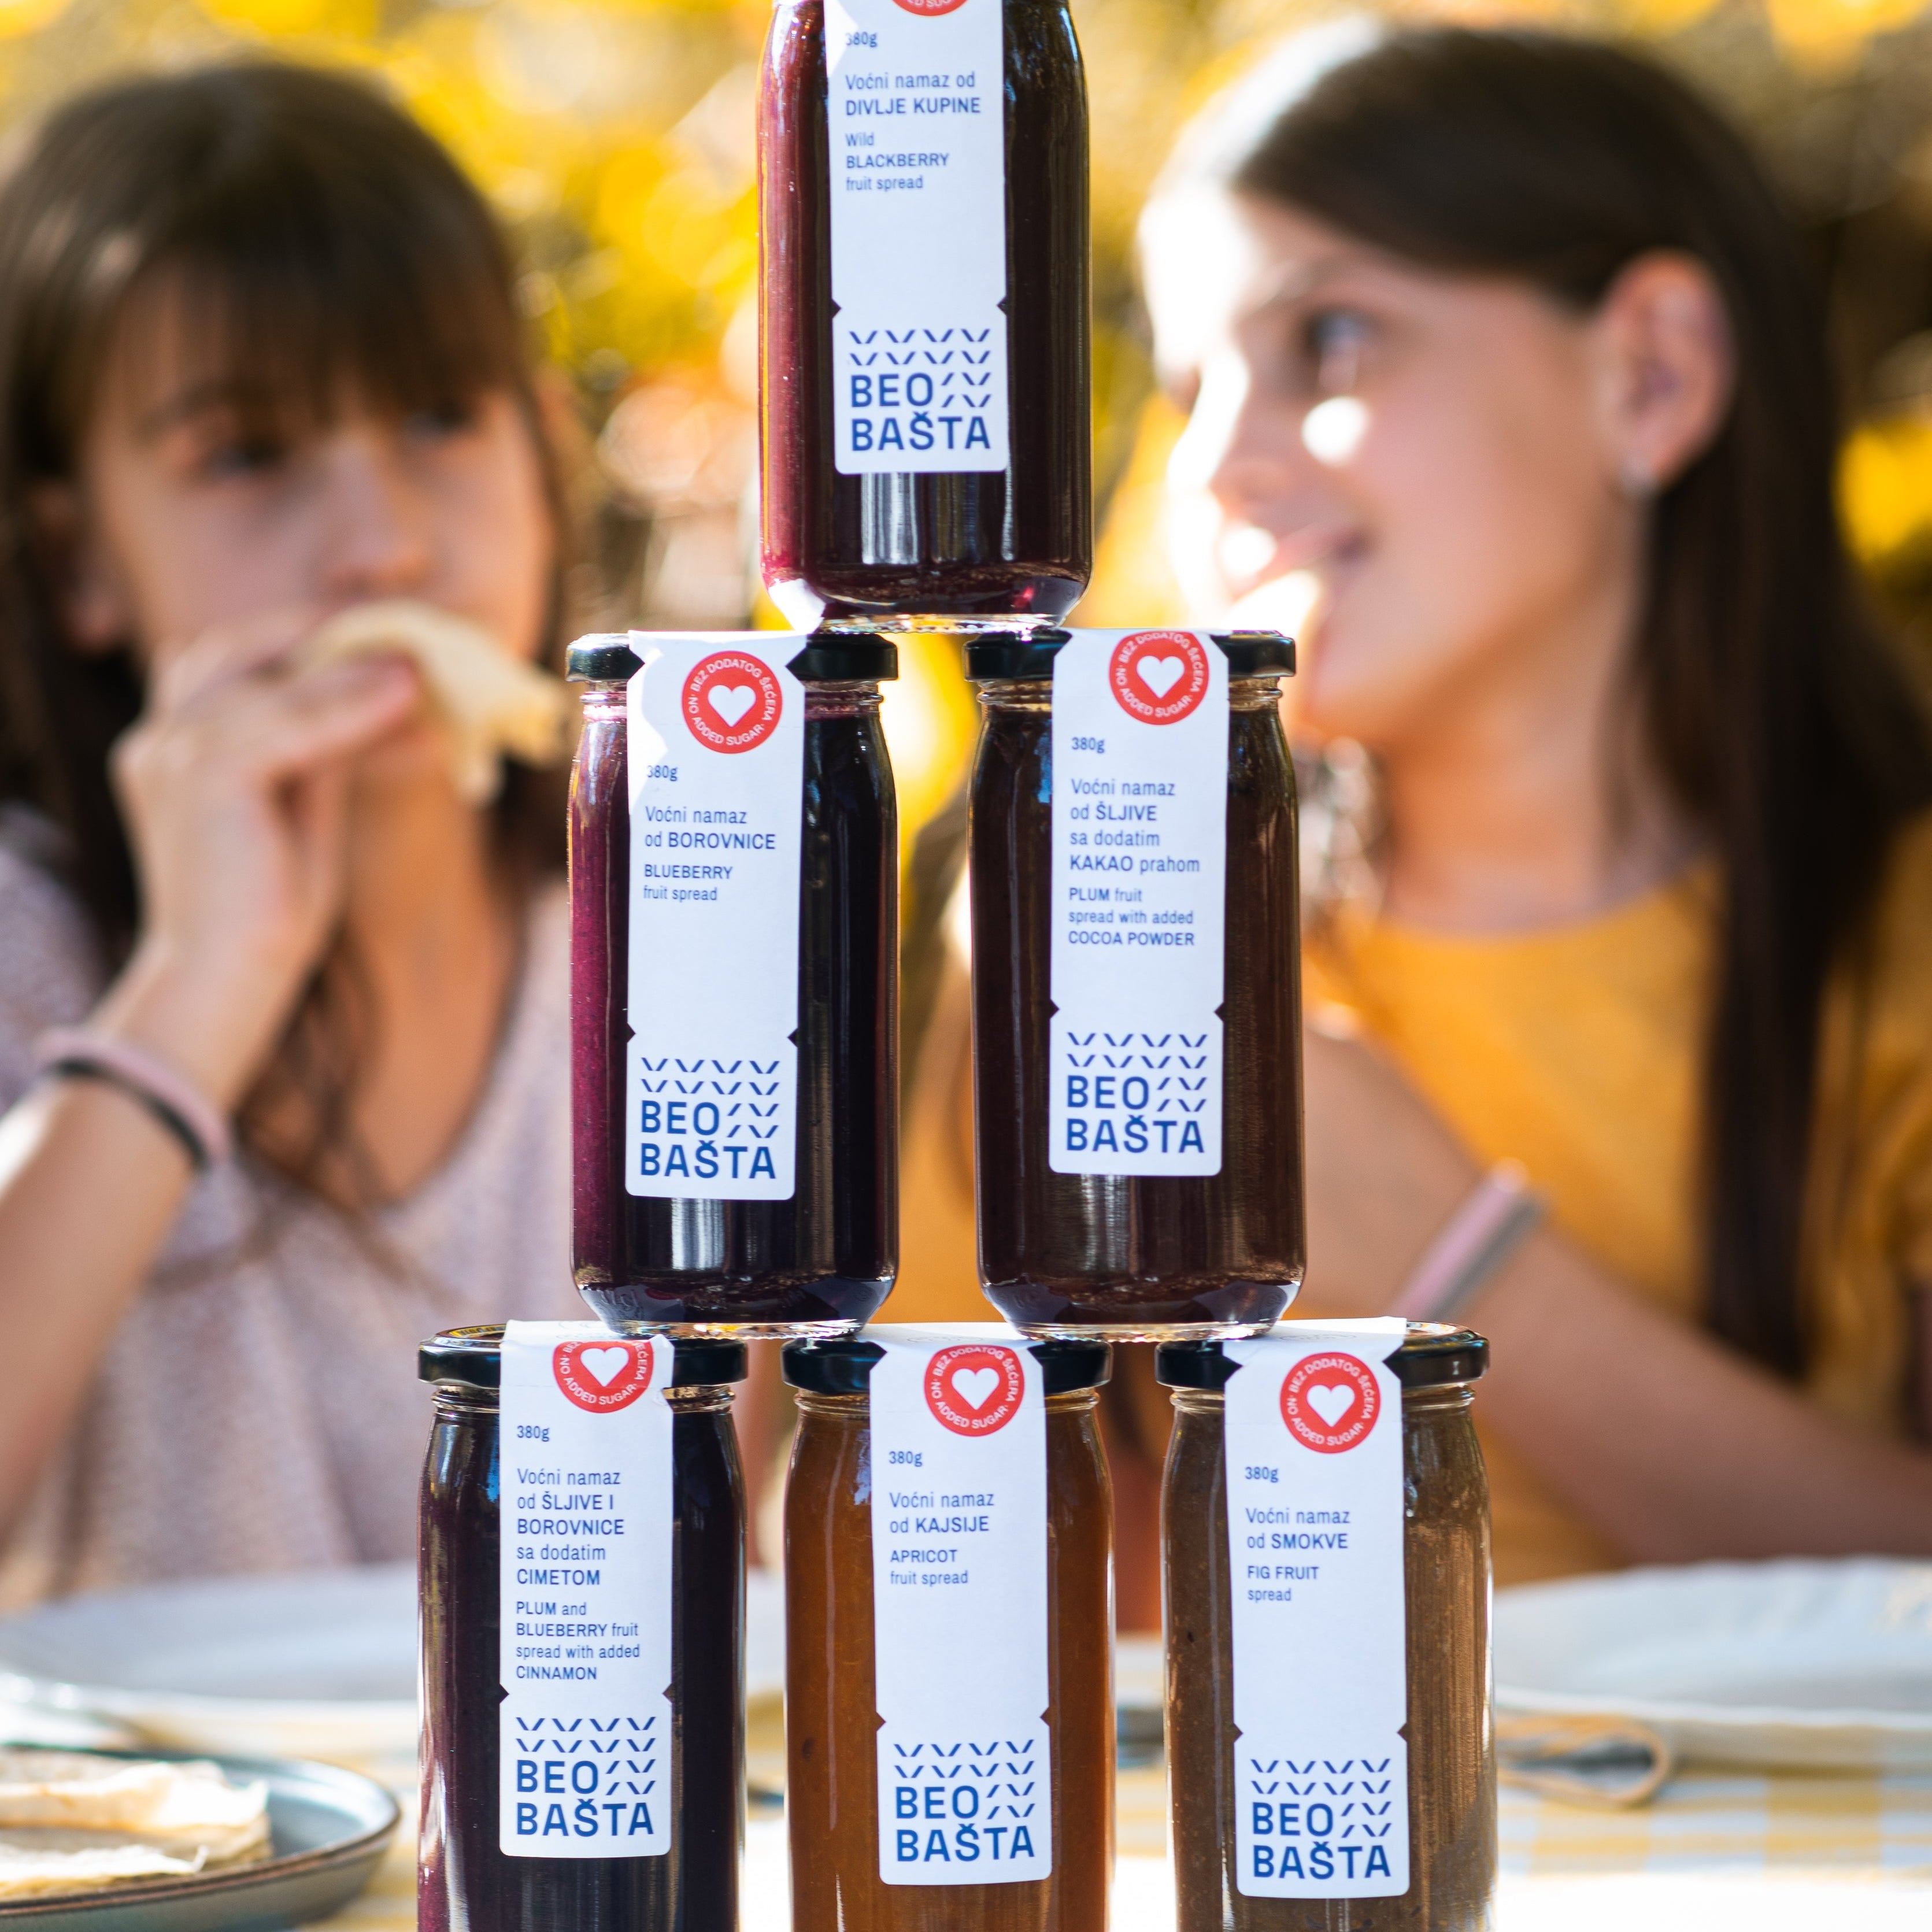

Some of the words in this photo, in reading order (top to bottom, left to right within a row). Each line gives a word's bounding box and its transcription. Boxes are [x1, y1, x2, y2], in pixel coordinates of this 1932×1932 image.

[845, 31, 878, 48] 380g
[845, 72, 889, 90] Voćni
[895, 75, 950, 88] namaz
[956, 71, 975, 88] od
[846, 98, 906, 116] DIVLJE
[914, 97, 980, 113] KUPINE
[845, 133, 874, 146] Wild
[846, 153, 949, 169] BLACKBERRY
[846, 176, 872, 191] fruit
[876, 175, 923, 192] spread
[851, 372, 933, 408] BEO
[852, 411, 990, 451] BAŠTA
[1118, 641, 1138, 663] BEZ
[690, 670, 709, 692] BEZ
[706, 658, 762, 678] DODATOG
[1120, 688, 1153, 716] ADDED
[1155, 695, 1193, 717] SUGAR
[692, 717, 724, 743] ADDED
[726, 724, 764, 745] SUGAR
[1072, 737, 1105, 754] 380g
[647, 765, 678, 782] 380g
[1071, 779, 1115, 795] Voćni
[1122, 783, 1175, 796] namaz
[645, 806, 686, 822] Voćni
[694, 810, 747, 824] namaz
[1071, 804, 1090, 820] od
[1096, 801, 1157, 821] ŠLJIVE
[645, 831, 662, 847] od
[668, 832, 775, 849] BOROVNICE
[1070, 832, 1088, 845] sa
[1094, 830, 1160, 846] dodatim
[645, 864, 732, 879] BLUEBERRY
[1070, 855, 1133, 871] KAKAO
[1140, 856, 1200, 875] prahom
[643, 885, 668, 899] fruit
[672, 887, 717, 902] spread
[1069, 887, 1110, 901] PLUM
[1114, 888, 1142, 902] fruit
[1068, 910, 1114, 926] spread
[1119, 911, 1147, 923] with
[1152, 911, 1193, 924] added
[1068, 931, 1123, 945] COCOA
[1128, 932, 1194, 946] POWDER
[1067, 1075, 1149, 1110] BEO
[642, 1100, 720, 1135] BEO
[1067, 1115, 1204, 1153] BAŠTA
[641, 1140, 776, 1179] BAŠTA
[932, 1355, 952, 1376] BEZ
[949, 1347, 1005, 1360] DODATOG
[1288, 1371, 1307, 1393] BEZ
[1304, 1358, 1360, 1377] DODATOG
[564, 1378, 597, 1404] ADDED
[598, 1384, 637, 1405] SUGAR
[935, 1401, 969, 1427] ADDED
[971, 1406, 1008, 1428] SUGAR
[517, 1426, 550, 1442] 380g
[1291, 1417, 1324, 1444] ADDED
[1327, 1422, 1364, 1446] SUGAR
[889, 1451, 923, 1467] 380g
[517, 1468, 560, 1485] Voćni
[568, 1472, 621, 1485] namaz
[1245, 1467, 1279, 1483] 380g
[517, 1494, 535, 1509] od
[542, 1491, 602, 1510] ŠLJIVE
[609, 1494, 613, 1509] I
[889, 1491, 934, 1508] Voćni
[941, 1494, 994, 1507] namaz
[890, 1517, 909, 1533] od
[916, 1516, 989, 1533] KAJSIJE
[1245, 1508, 1289, 1524] Voćni
[1297, 1511, 1350, 1524] namaz
[518, 1519, 624, 1535] BOROVNICE
[1247, 1533, 1265, 1549] od
[1271, 1533, 1348, 1549] SMOKVE
[517, 1547, 534, 1559] sa
[541, 1544, 605, 1560] dodatim
[890, 1549, 957, 1563] APRICOT
[517, 1569, 600, 1585] CIMETOM
[890, 1571, 917, 1585] fruit
[921, 1570, 968, 1587] spread
[1248, 1565, 1270, 1579] FIG
[1275, 1566, 1319, 1579] FRUIT
[1248, 1588, 1291, 1603] spread
[517, 1601, 556, 1615] PLUM
[562, 1602, 586, 1615] and
[517, 1623, 608, 1637] BLUEBERRY
[612, 1623, 638, 1636] fruit
[516, 1645, 561, 1660] spread
[565, 1645, 593, 1658] with
[599, 1644, 640, 1658] added
[516, 1665, 597, 1680] CINNAMON
[517, 1760, 598, 1794] BEO
[896, 1785, 979, 1819] BEO
[517, 1798, 654, 1837] BAŠTA
[1253, 1802, 1333, 1837] BEO
[897, 1823, 1034, 1861] BAŠTA
[1253, 1841, 1391, 1879] BAŠTA
